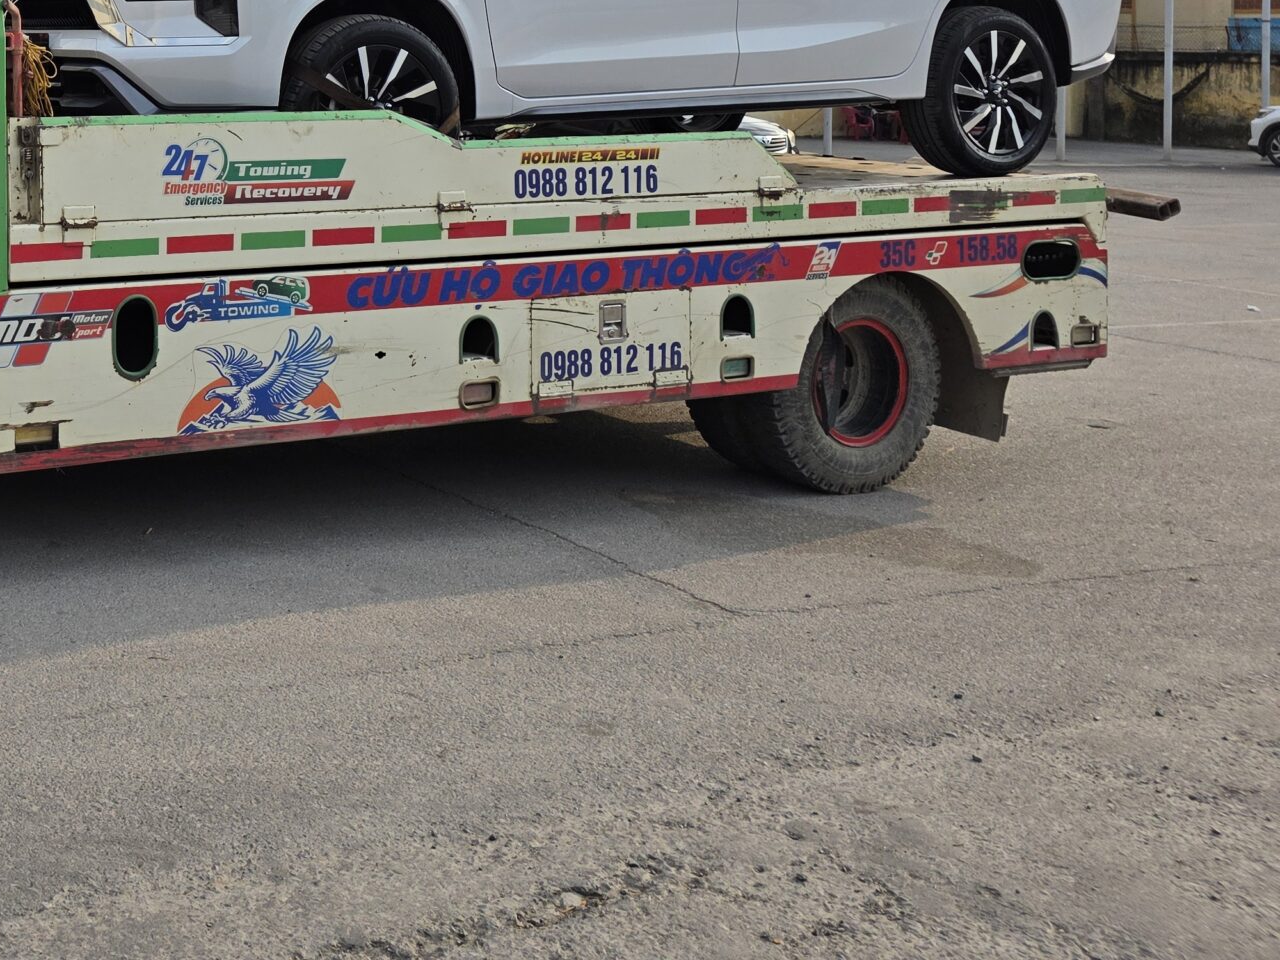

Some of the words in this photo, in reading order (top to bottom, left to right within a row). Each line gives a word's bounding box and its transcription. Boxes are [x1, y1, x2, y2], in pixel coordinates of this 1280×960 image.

[521, 151, 577, 165] HOTLINE
[234, 163, 312, 178] Towing
[164, 182, 228, 195] Emergency
[514, 167, 567, 198] 0988
[575, 166, 614, 195] 812
[620, 164, 658, 193] 116
[234, 185, 342, 200] Recovery
[185, 195, 223, 206] Services
[880, 241, 916, 268] 35C
[957, 234, 1017, 263] 158.58
[347, 265, 431, 309] CỨU
[439, 259, 502, 310] HỘ
[512, 259, 611, 297] GIAO
[622, 247, 747, 288] THÔNG
[219, 304, 280, 317] TOWING
[74, 314, 109, 323] Motor
[540, 348, 592, 382] 0988
[600, 344, 638, 376] 812
[646, 341, 682, 371] 116
